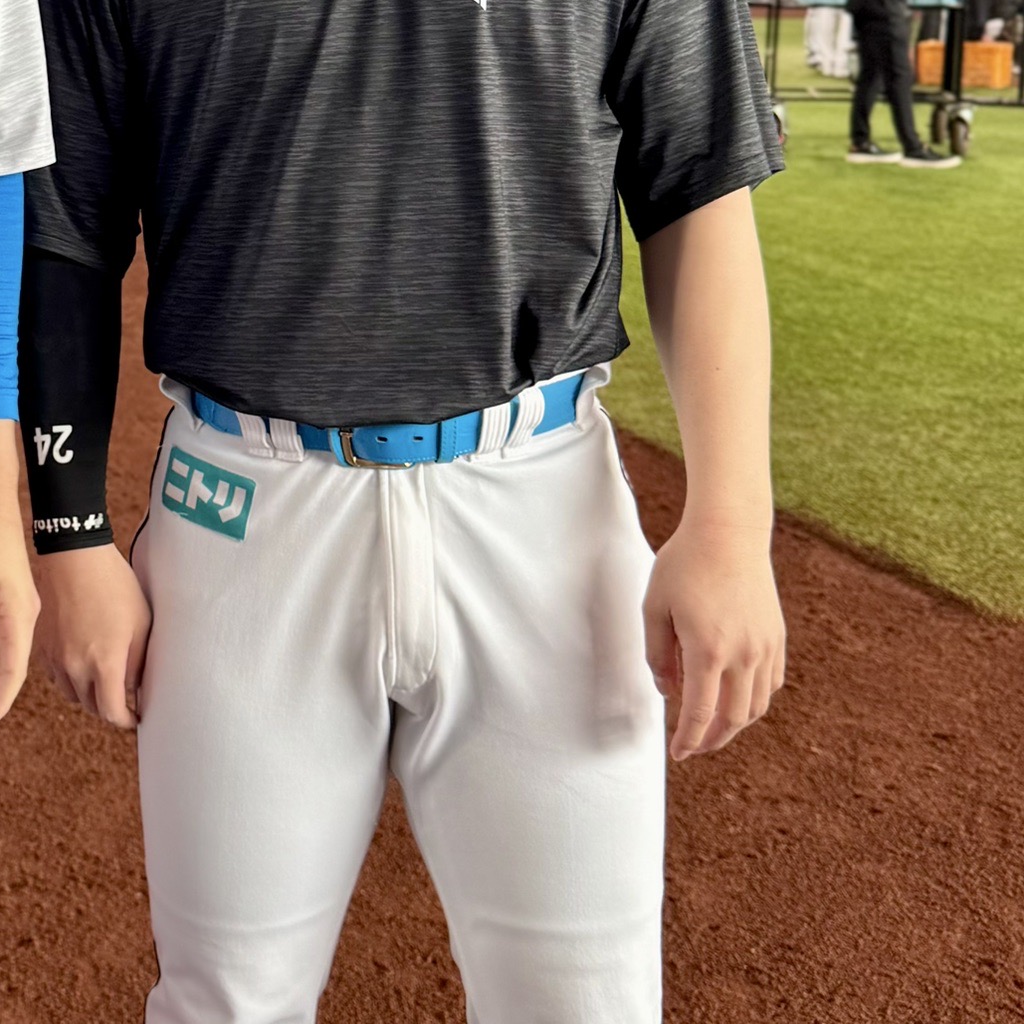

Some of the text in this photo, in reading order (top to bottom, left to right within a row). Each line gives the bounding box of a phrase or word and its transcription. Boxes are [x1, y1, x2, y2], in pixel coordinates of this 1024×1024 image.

[33, 424, 74, 466] 24
[164, 458, 247, 523] ニトリ
